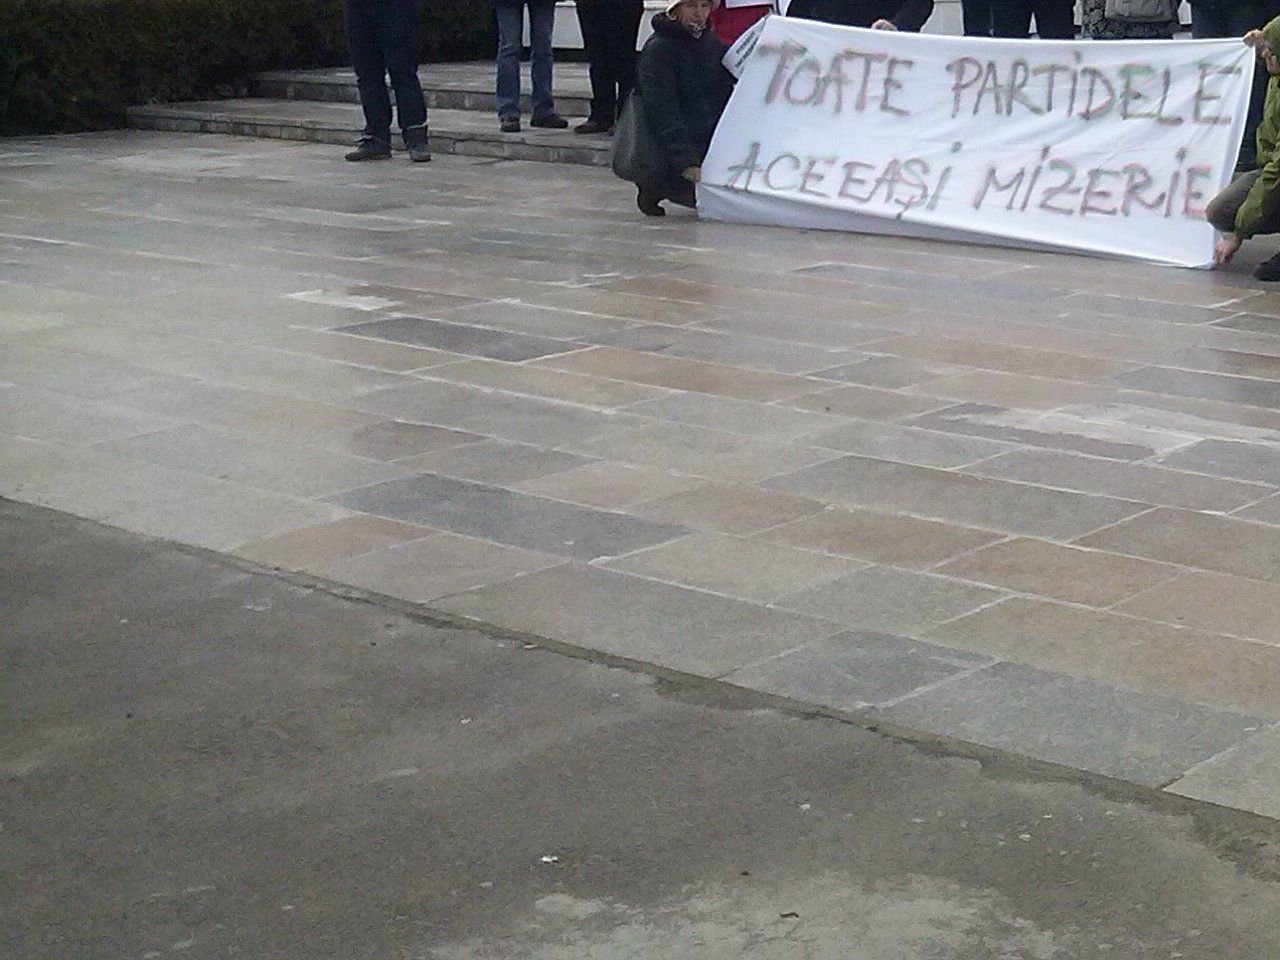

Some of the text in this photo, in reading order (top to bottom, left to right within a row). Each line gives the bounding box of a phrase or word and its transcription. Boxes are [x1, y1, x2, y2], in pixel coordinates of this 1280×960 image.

[757, 38, 915, 117] TOATE
[947, 50, 1242, 127] PARTIDELE
[973, 145, 1214, 218] MIZERIE
